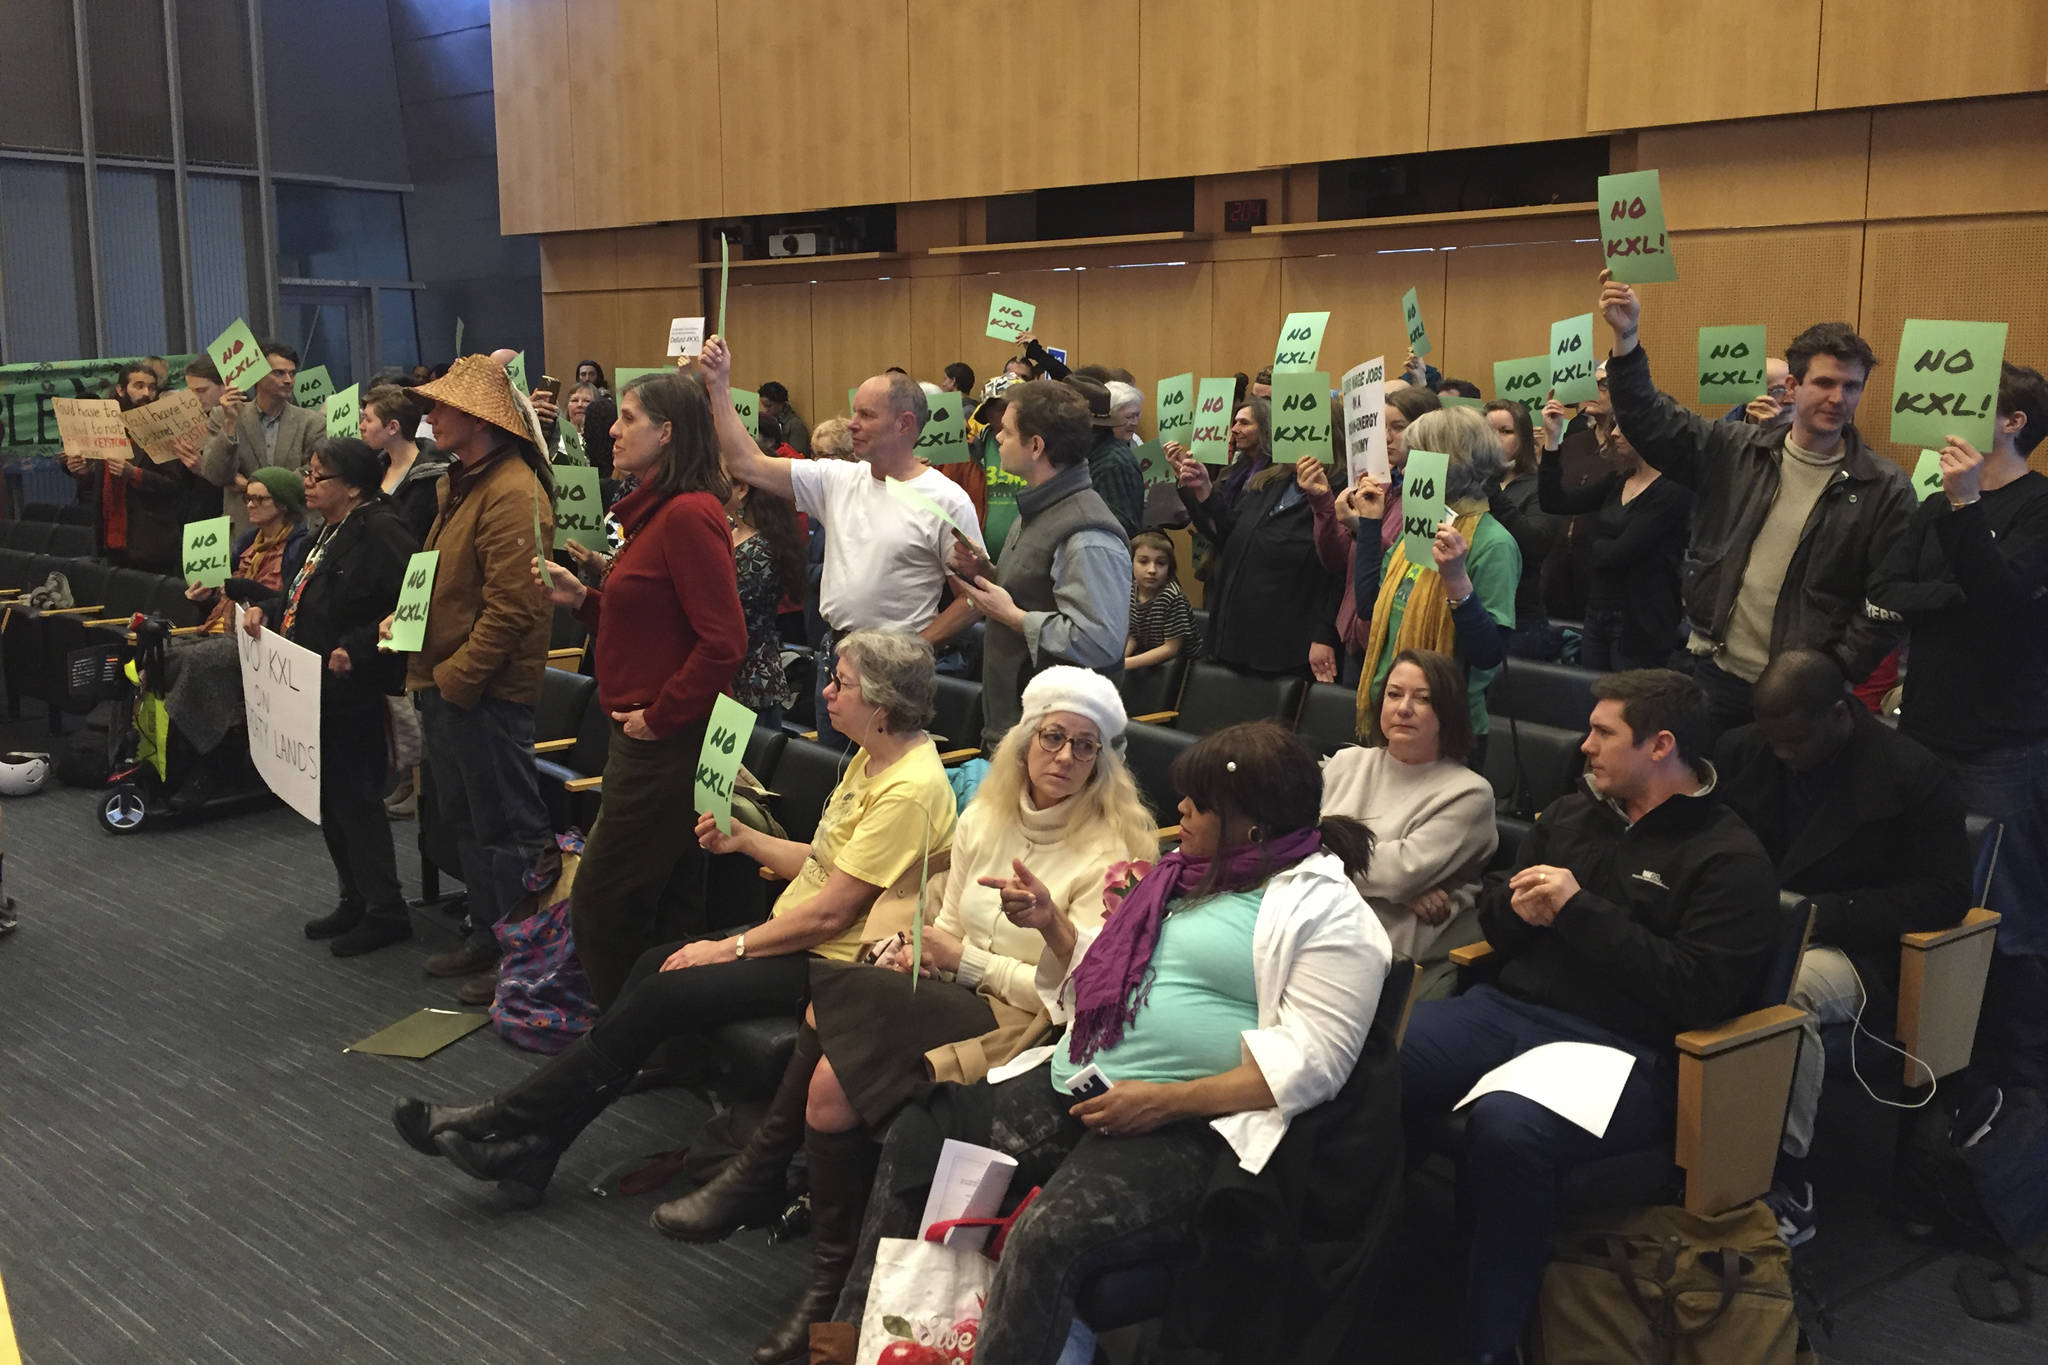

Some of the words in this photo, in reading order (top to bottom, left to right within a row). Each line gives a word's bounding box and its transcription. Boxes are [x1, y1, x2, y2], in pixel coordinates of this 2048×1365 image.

[1610, 196, 1646, 221] NO
[1607, 233, 1665, 258] KXL!
[999, 306, 1023, 318] NO
[1407, 303, 1416, 322] NO
[990, 318, 1030, 334] KXL!
[1287, 327, 1312, 341] NO
[1410, 321, 1425, 345] KXL!
[223, 339, 244, 365] NO
[1557, 334, 1582, 355] NO
[1710, 342, 1750, 360] NO
[225, 348, 260, 387] KXL!
[1276, 351, 1316, 365] KXL!
[1914, 348, 1974, 374] NO
[1366, 365, 1383, 385] JOBS
[1505, 372, 1541, 391] NO
[1553, 361, 1593, 385] KXL!
[1700, 368, 1762, 387] KXL!
[300, 379, 322, 393] NO
[1163, 390, 1184, 407] NO
[1203, 396, 1224, 413] NO
[1283, 393, 1317, 412] NO
[1895, 391, 1991, 419] KXL!
[104, 402, 118, 419] to
[147, 403, 182, 422] have
[181, 397, 199, 411] to
[332, 403, 350, 422] NO
[174, 418, 189, 433] to
[1160, 411, 1193, 432] KXL!
[1193, 425, 1229, 442] KXL!
[1274, 425, 1330, 442] KXL!
[555, 484, 587, 502] NO
[1410, 478, 1435, 500] NO
[1404, 516, 1443, 539] KXL
[191, 533, 217, 550] NO
[186, 554, 227, 575] KXL!
[407, 568, 426, 590] NO
[395, 601, 428, 622] KXL!
[269, 647, 300, 692] KXL
[710, 725, 736, 755] NO
[696, 763, 733, 803] KXL!
